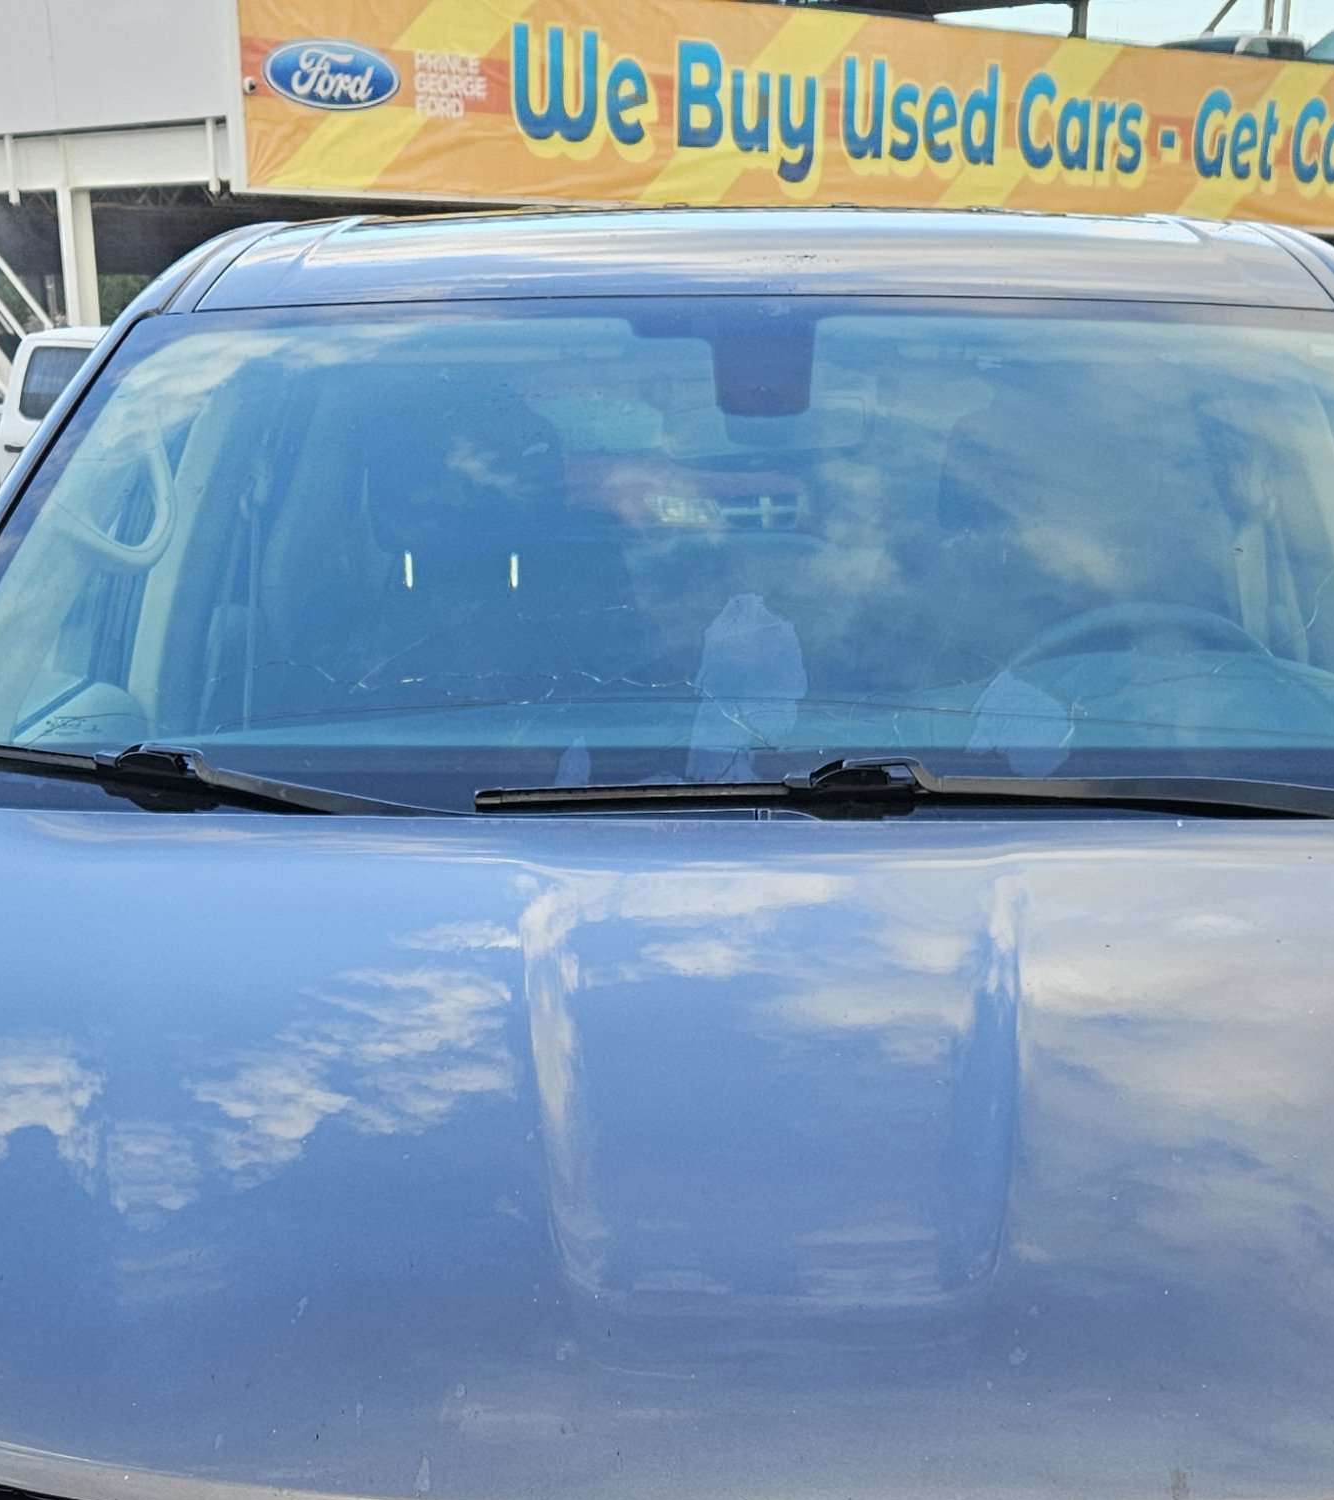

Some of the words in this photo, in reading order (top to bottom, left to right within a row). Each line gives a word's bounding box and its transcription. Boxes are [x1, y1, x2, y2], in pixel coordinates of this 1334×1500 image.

[291, 49, 375, 102] Ford
[414, 52, 481, 76] PRINCE
[414, 74, 487, 100] GEORGE
[415, 97, 465, 118] FORD
[512, 22, 649, 145] We
[676, 40, 818, 184] Buy
[842, 56, 1000, 166] Used
[1018, 72, 1143, 172] Cars
[1194, 88, 1280, 181] Get
